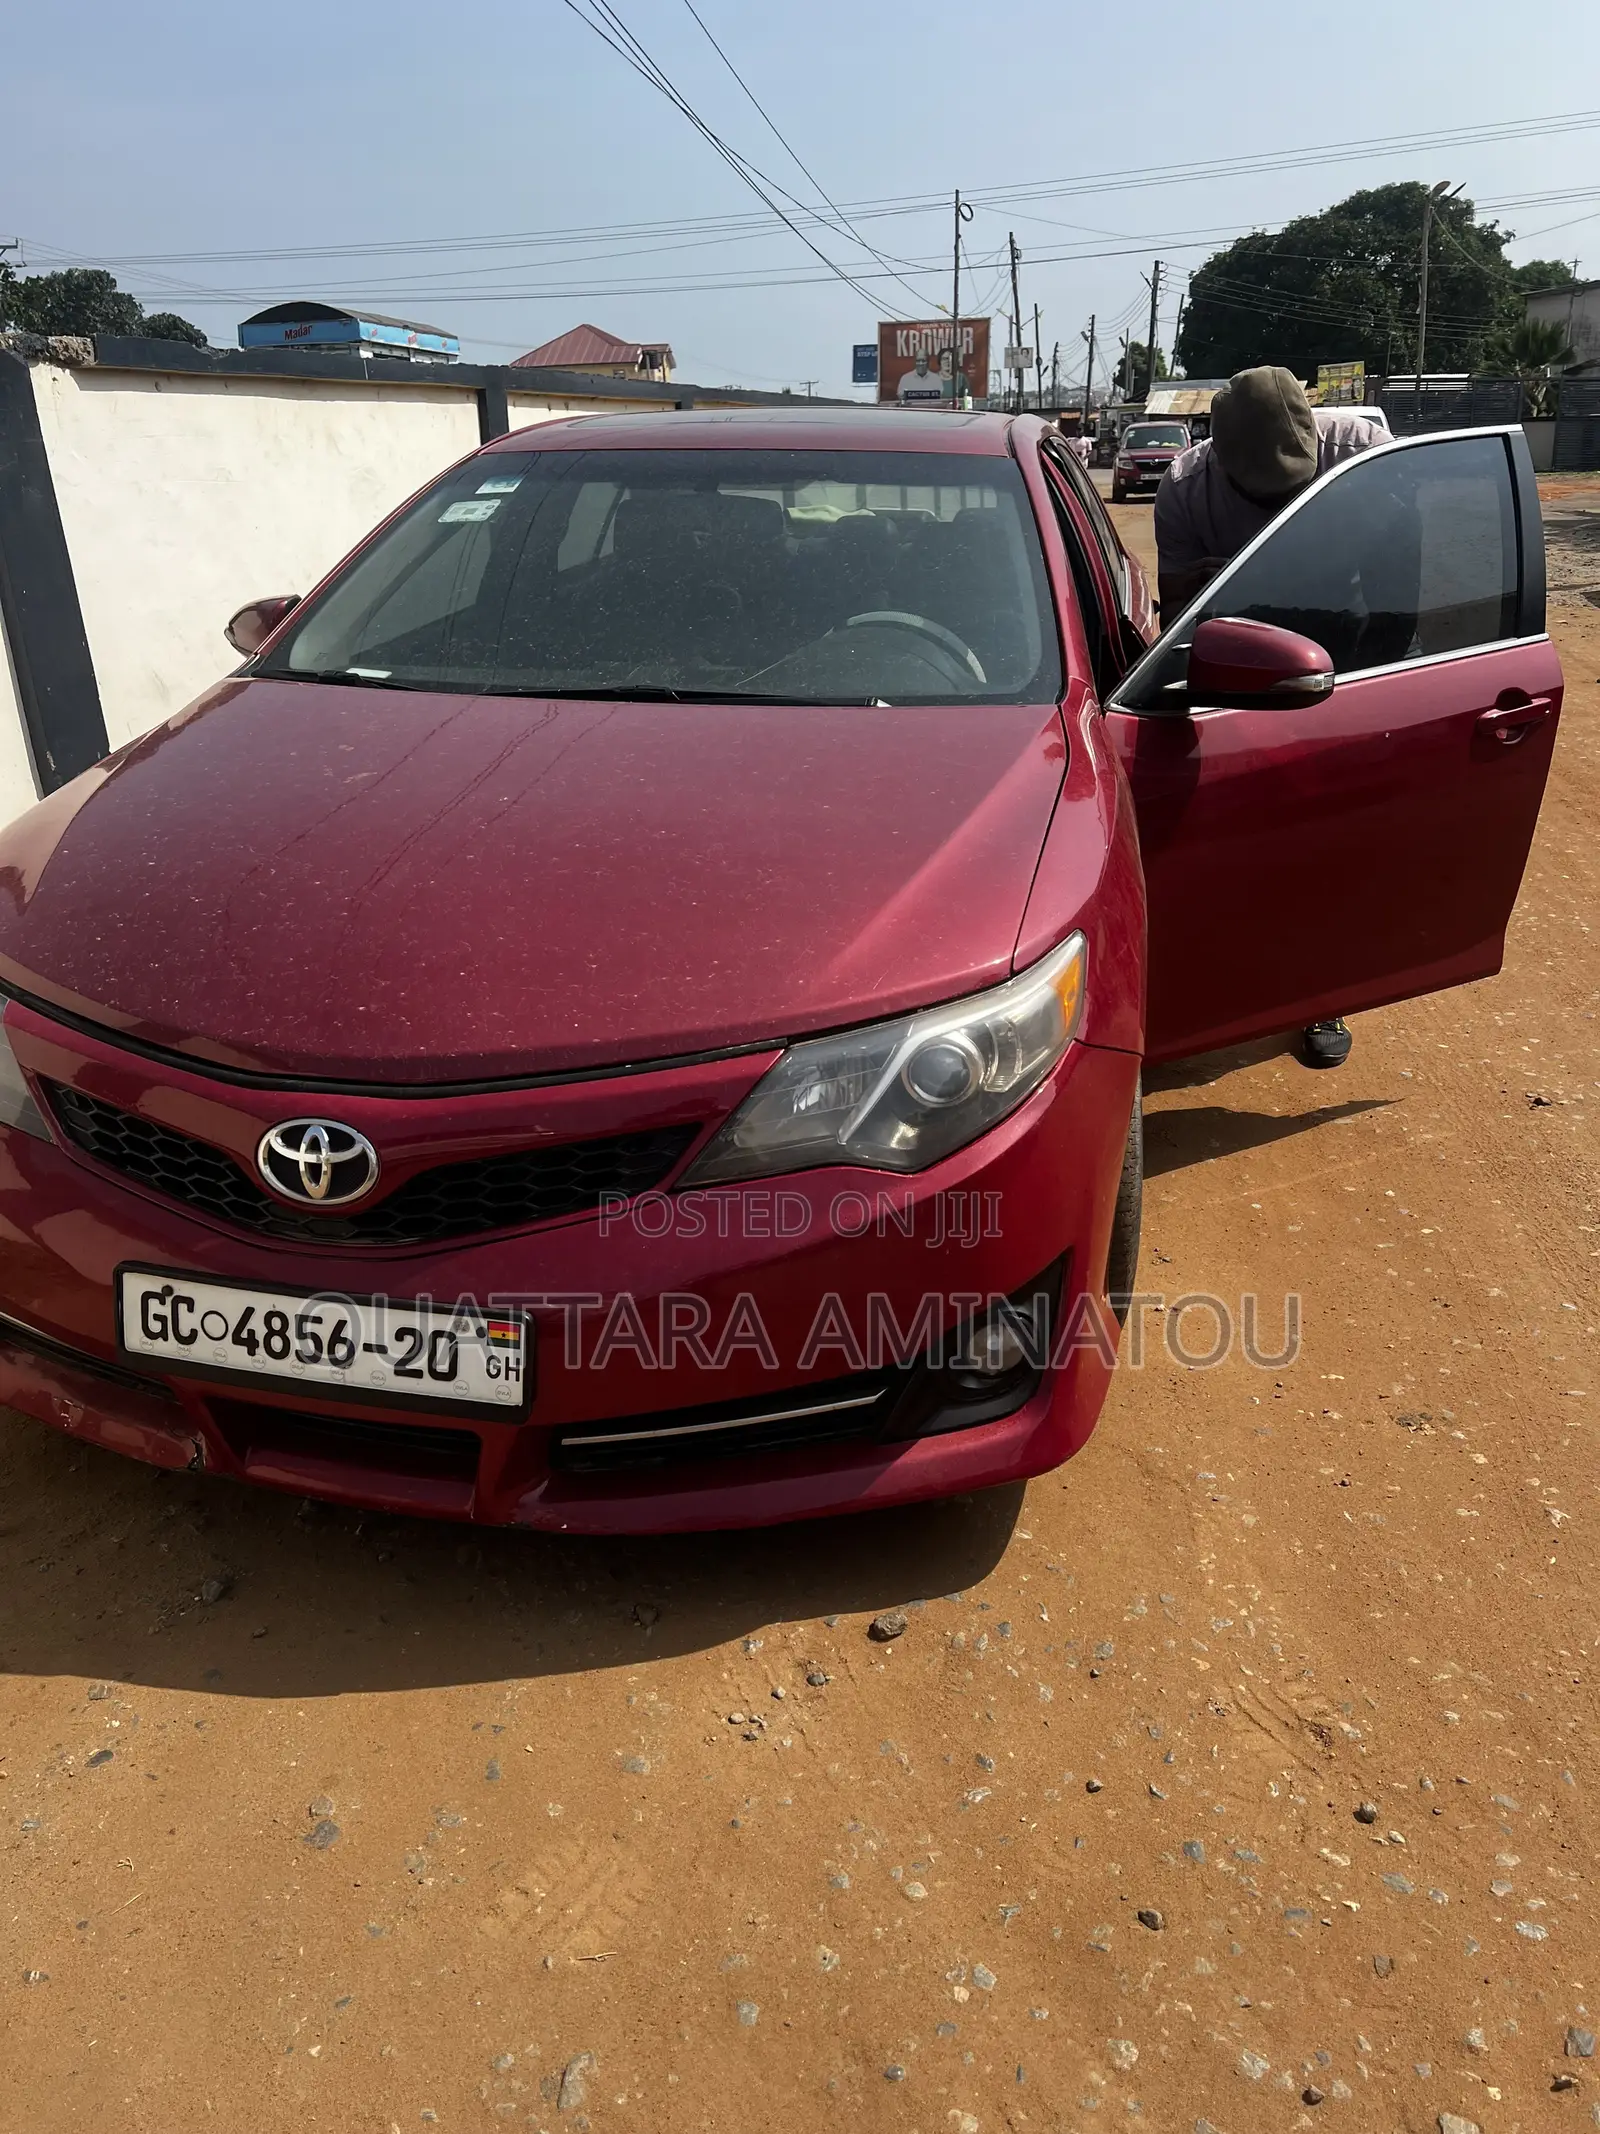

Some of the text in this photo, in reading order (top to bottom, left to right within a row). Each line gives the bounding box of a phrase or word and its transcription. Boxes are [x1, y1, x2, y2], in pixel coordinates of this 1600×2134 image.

[284, 324, 313, 341] Madar
[141, 1291, 459, 1381] GC 4856-20
[486, 1355, 520, 1382] GH
